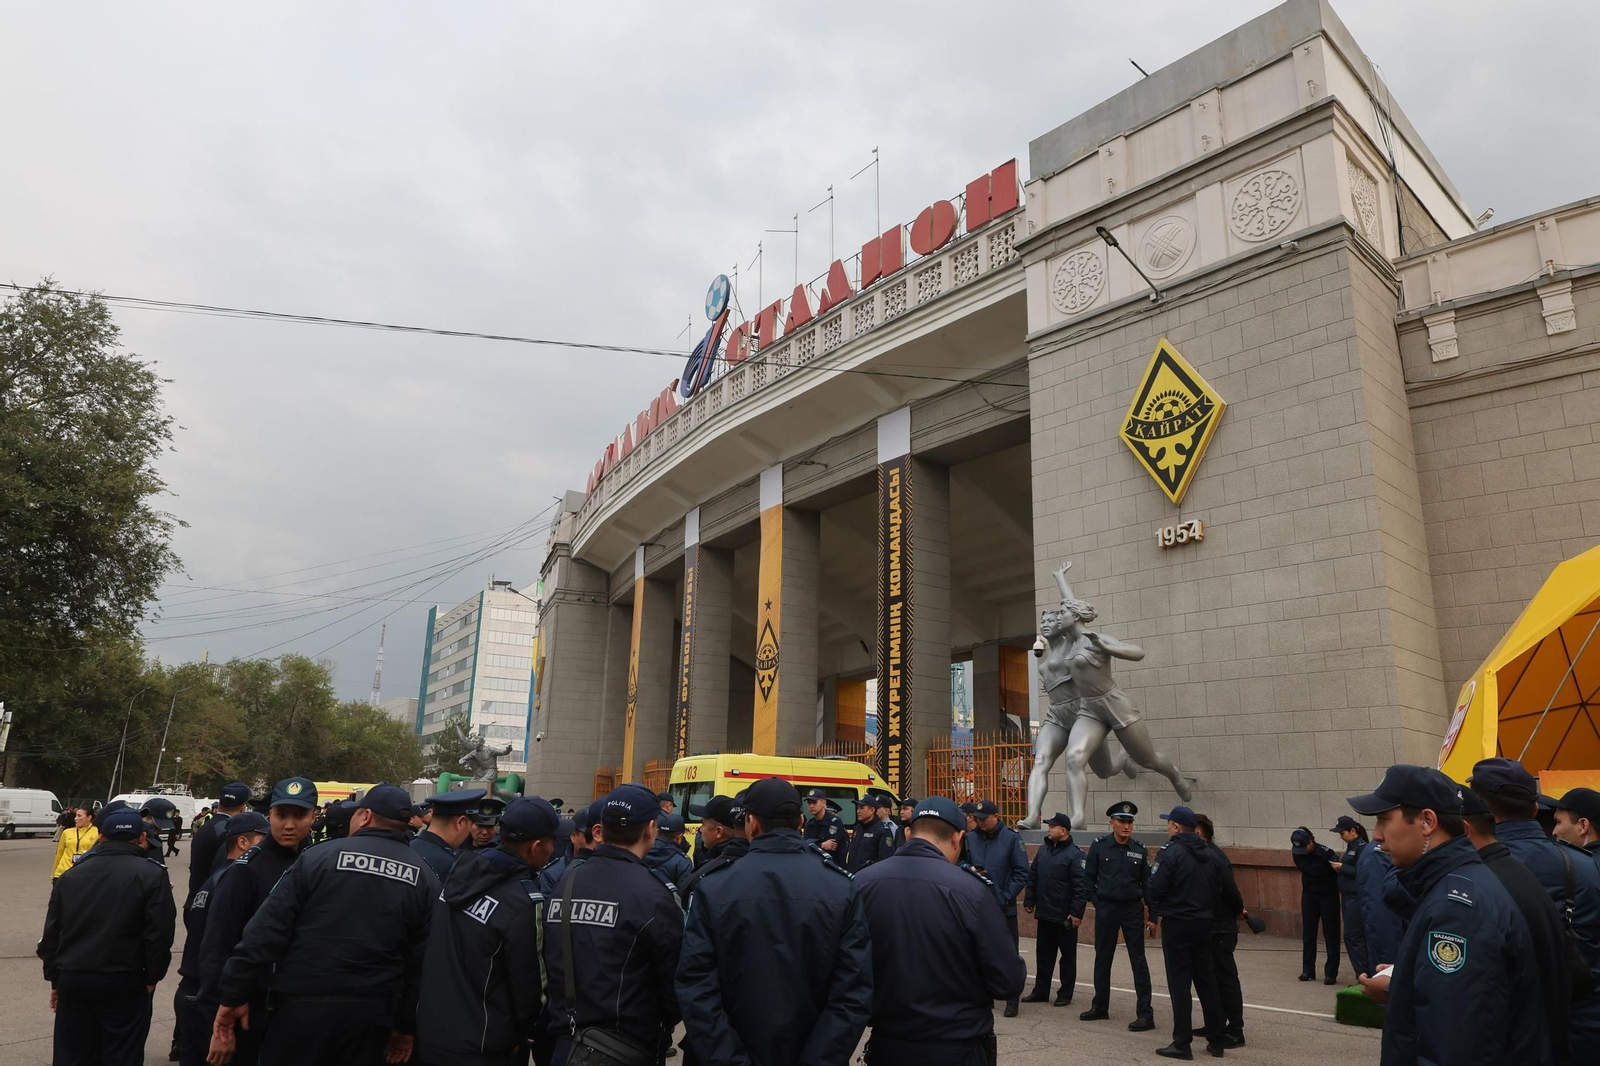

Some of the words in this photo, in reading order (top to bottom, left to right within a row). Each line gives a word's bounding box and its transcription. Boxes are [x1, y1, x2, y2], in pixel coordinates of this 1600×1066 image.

[726, 158, 1020, 366] СТАДИОН
[1135, 405, 1203, 439] ҚАЙРАТ
[889, 467, 902, 597] КОМАНДАСЫ
[1155, 519, 1203, 548] 1954
[685, 566, 694, 627] КЛУБЫ
[681, 631, 691, 702] ФУТБОЛ
[684, 765, 698, 780] 103
[888, 743, 901, 796] ЕНІҢ
[608, 800, 632, 811] POLISIA
[918, 809, 940, 817] POLISIA
[341, 854, 414, 881] POLISIA
[549, 901, 616, 924] PLISIA
[1433, 933, 1465, 944] QAZAQSTAN
